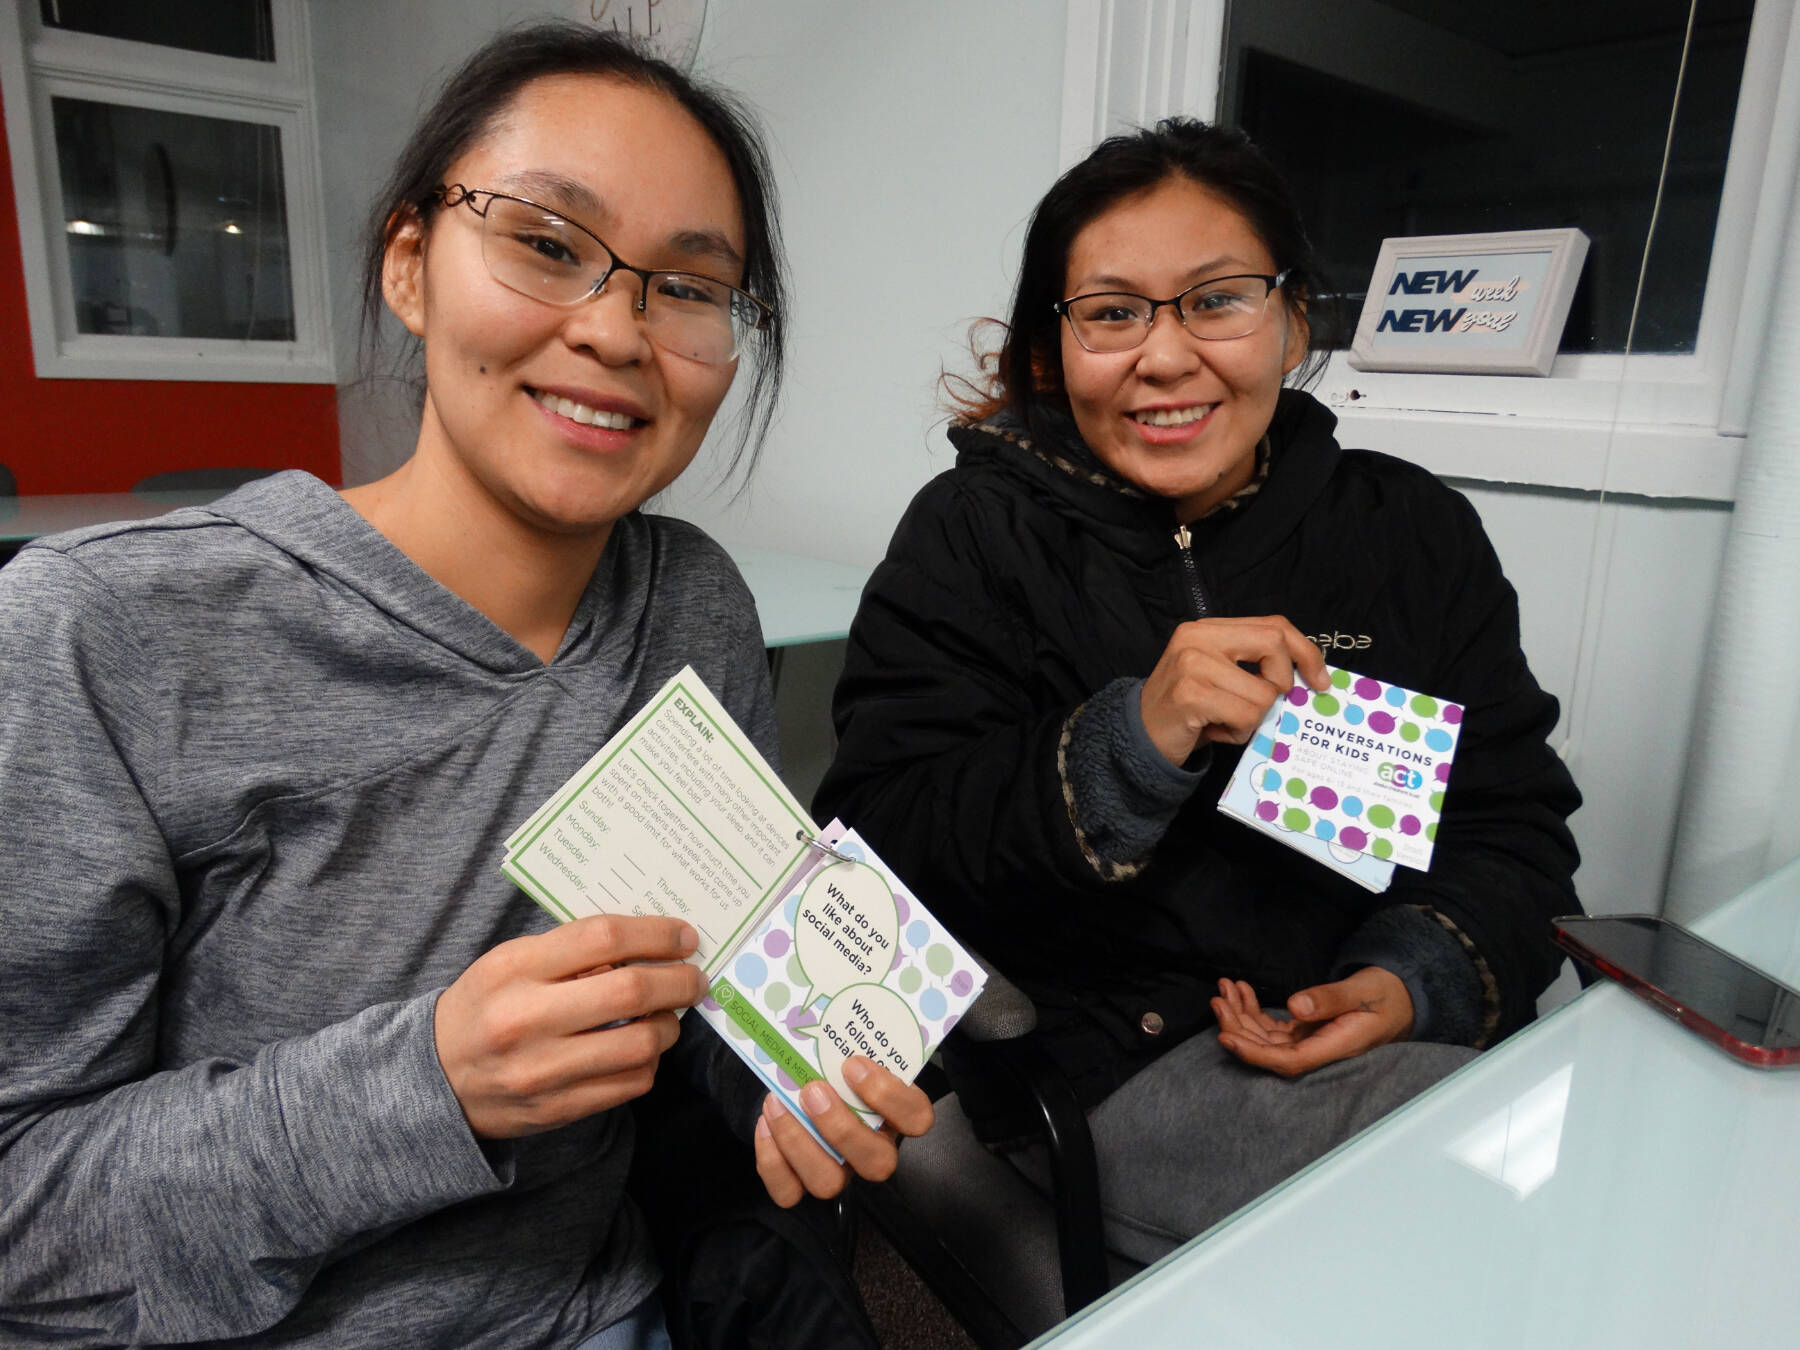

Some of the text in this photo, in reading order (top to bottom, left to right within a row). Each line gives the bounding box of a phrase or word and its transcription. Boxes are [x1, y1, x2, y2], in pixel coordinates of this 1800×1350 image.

[1388, 269, 1521, 302] NEW week
[1376, 308, 1518, 333] NEW goal
[672, 697, 716, 743] EXPLAIN:
[1299, 732, 1370, 762] FOR KIDS
[1303, 718, 1433, 766] CONVERSATIONS
[638, 735, 661, 759] make
[657, 757, 674, 775] you
[672, 771, 689, 789] feel
[654, 718, 782, 857] can interfere with many other important
[661, 708, 698, 747] Spending
[718, 770, 737, 790] time
[732, 786, 761, 816] looking
[764, 820, 792, 849] devices
[600, 776, 620, 796] with
[622, 800, 645, 824] good
[642, 819, 661, 839] limit
[658, 836, 673, 851] for
[670, 848, 690, 869] what
[688, 866, 711, 891] works
[708, 887, 721, 900] for
[719, 899, 730, 910] us
[608, 766, 743, 908] spent on screens this week and come up
[635, 776, 660, 802] check
[656, 799, 689, 834] together
[702, 846, 724, 869] much
[720, 866, 738, 885] time
[735, 884, 751, 899] you
[678, 761, 712, 797] including
[708, 795, 727, 815] your
[743, 832, 759, 848] and
[761, 852, 776, 867] can
[801, 907, 872, 976] social media?
[821, 902, 875, 956] like about
[824, 883, 890, 950] What do you
[728, 1000, 761, 1032] SOCIAL
[757, 1029, 787, 1058] MEDIA
[822, 1021, 854, 1059] social
[844, 1019, 878, 1060] follow
[849, 998, 909, 1072] Who do you
